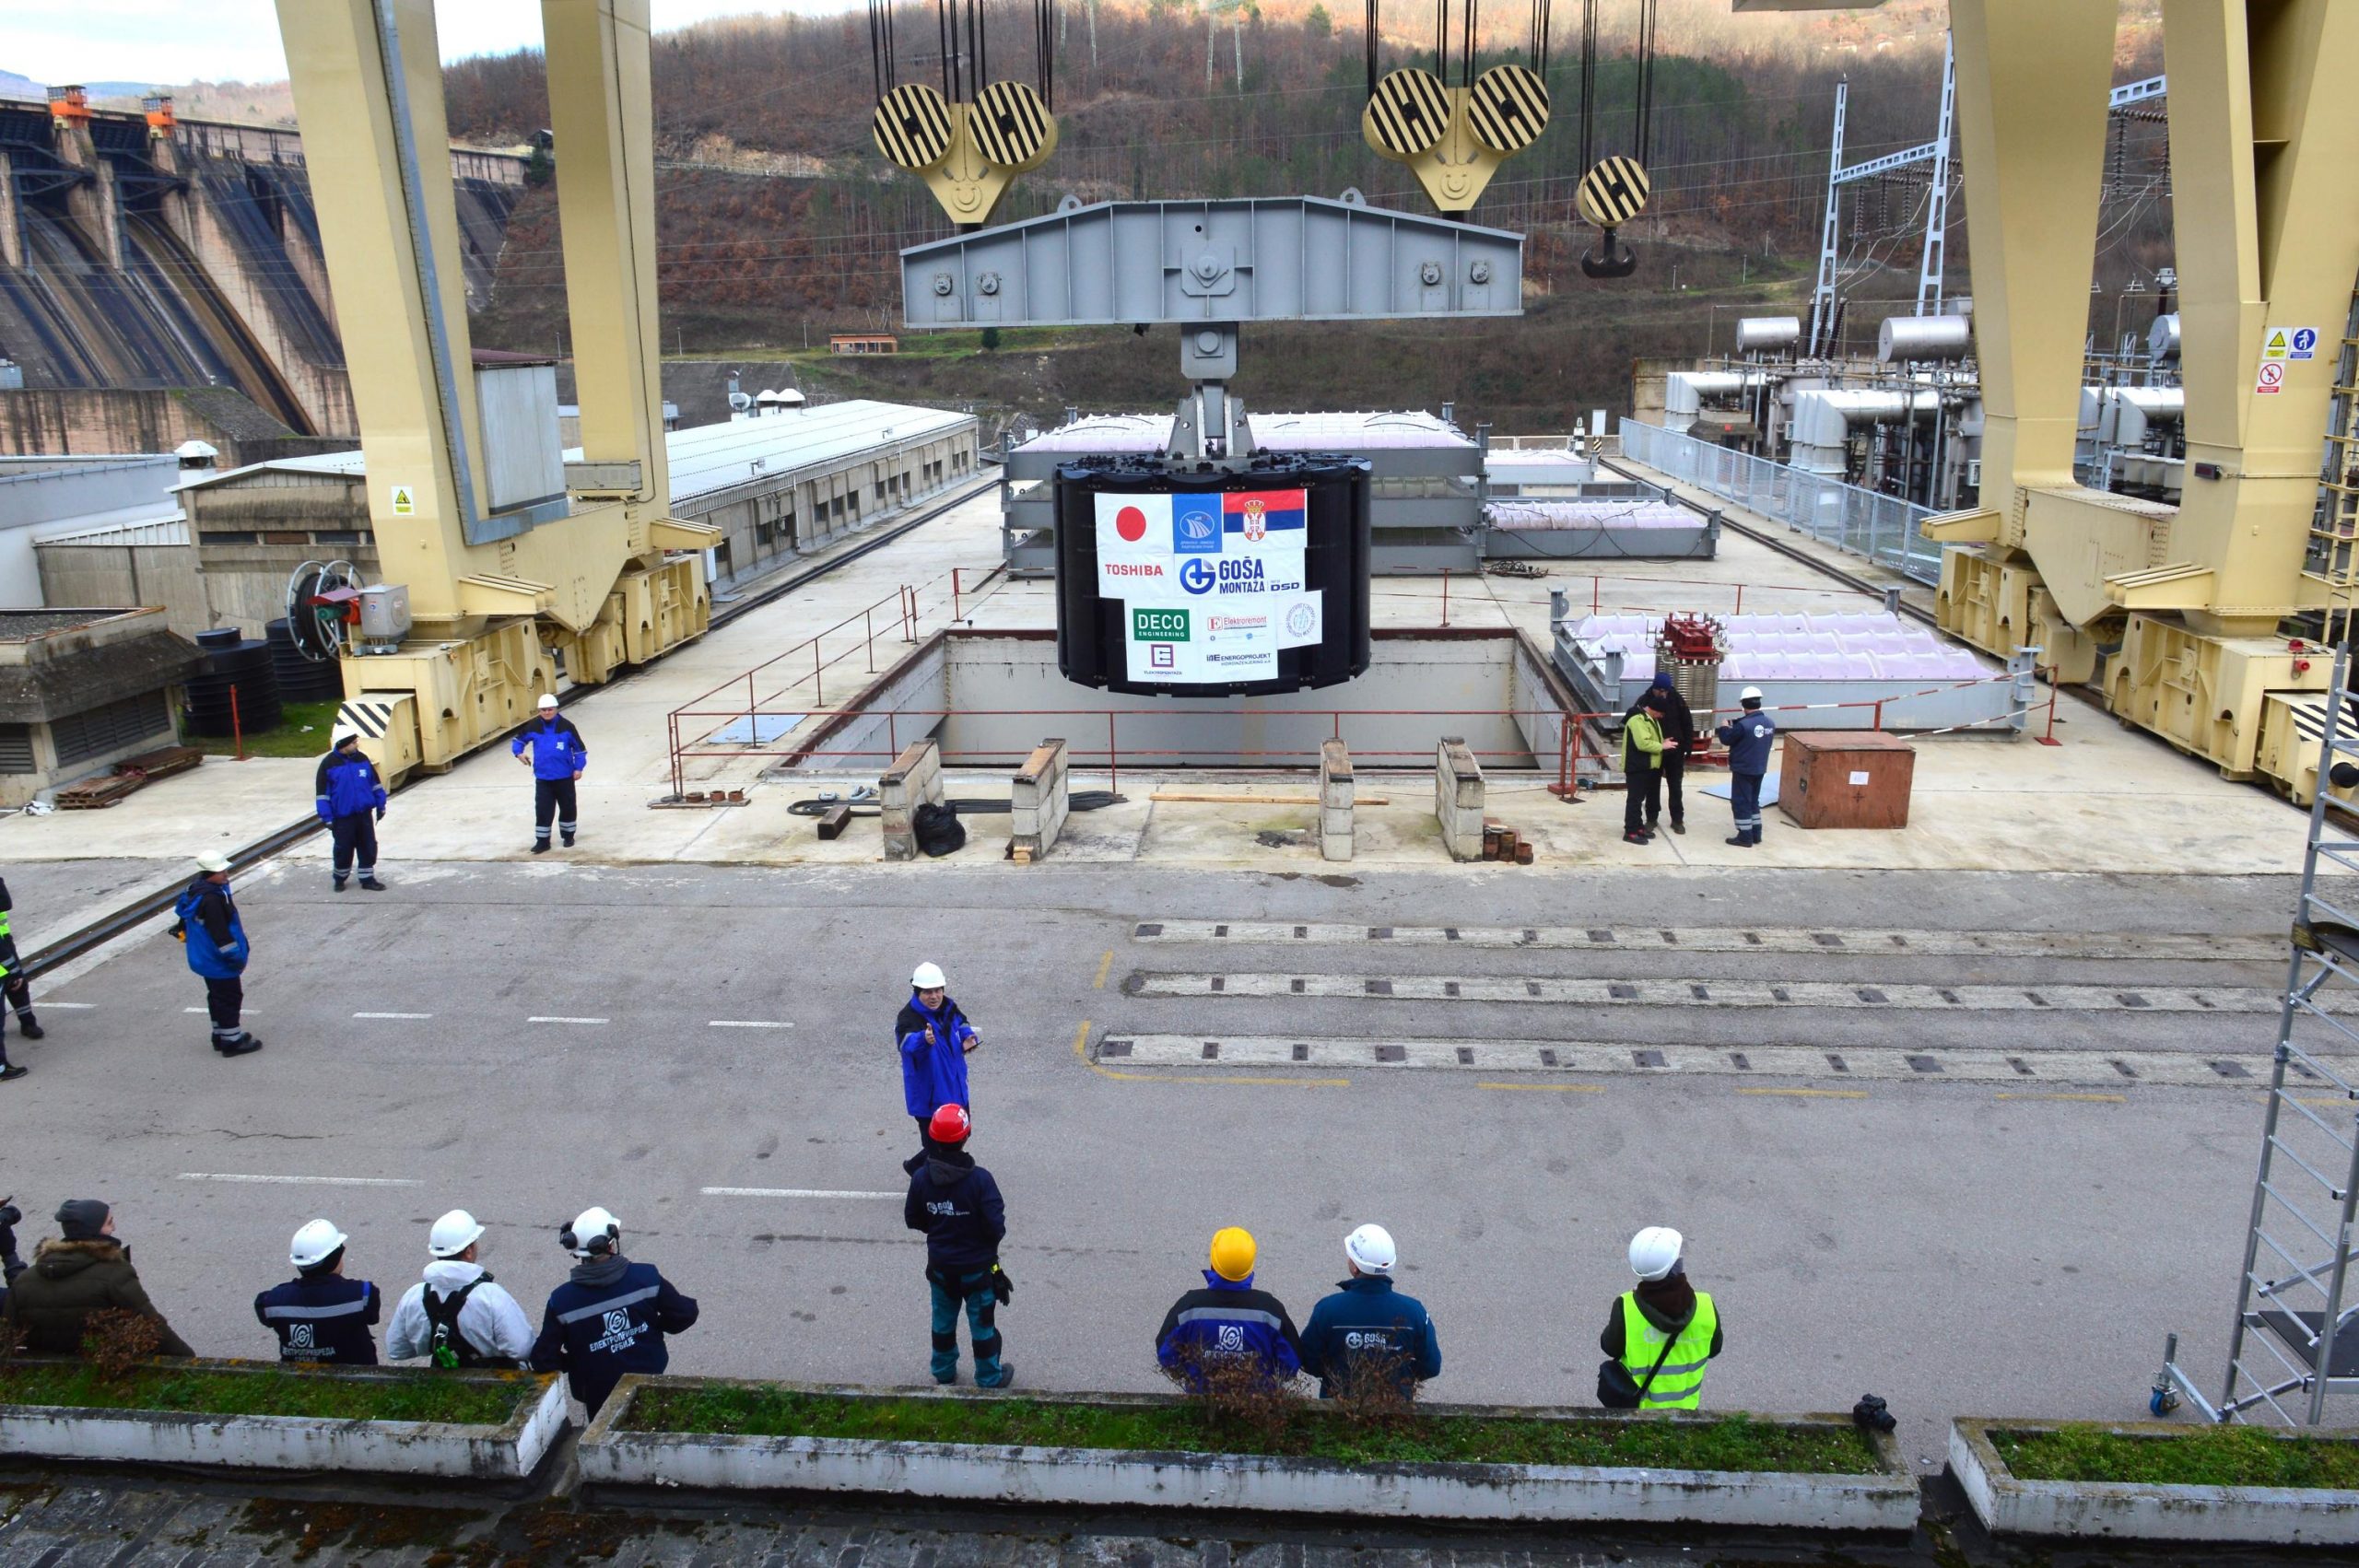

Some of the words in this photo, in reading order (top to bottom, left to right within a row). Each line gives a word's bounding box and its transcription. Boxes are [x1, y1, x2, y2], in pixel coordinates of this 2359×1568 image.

[1105, 564, 1164, 577] TOSHIBA
[1219, 556, 1264, 580] GOŠA
[1219, 579, 1265, 595] MONTAŽA
[1270, 581, 1300, 591] DSD
[1137, 614, 1184, 630] DECO
[1224, 616, 1267, 626] Elektroremont
[1221, 652, 1271, 661] ENERGOPROJEKT
